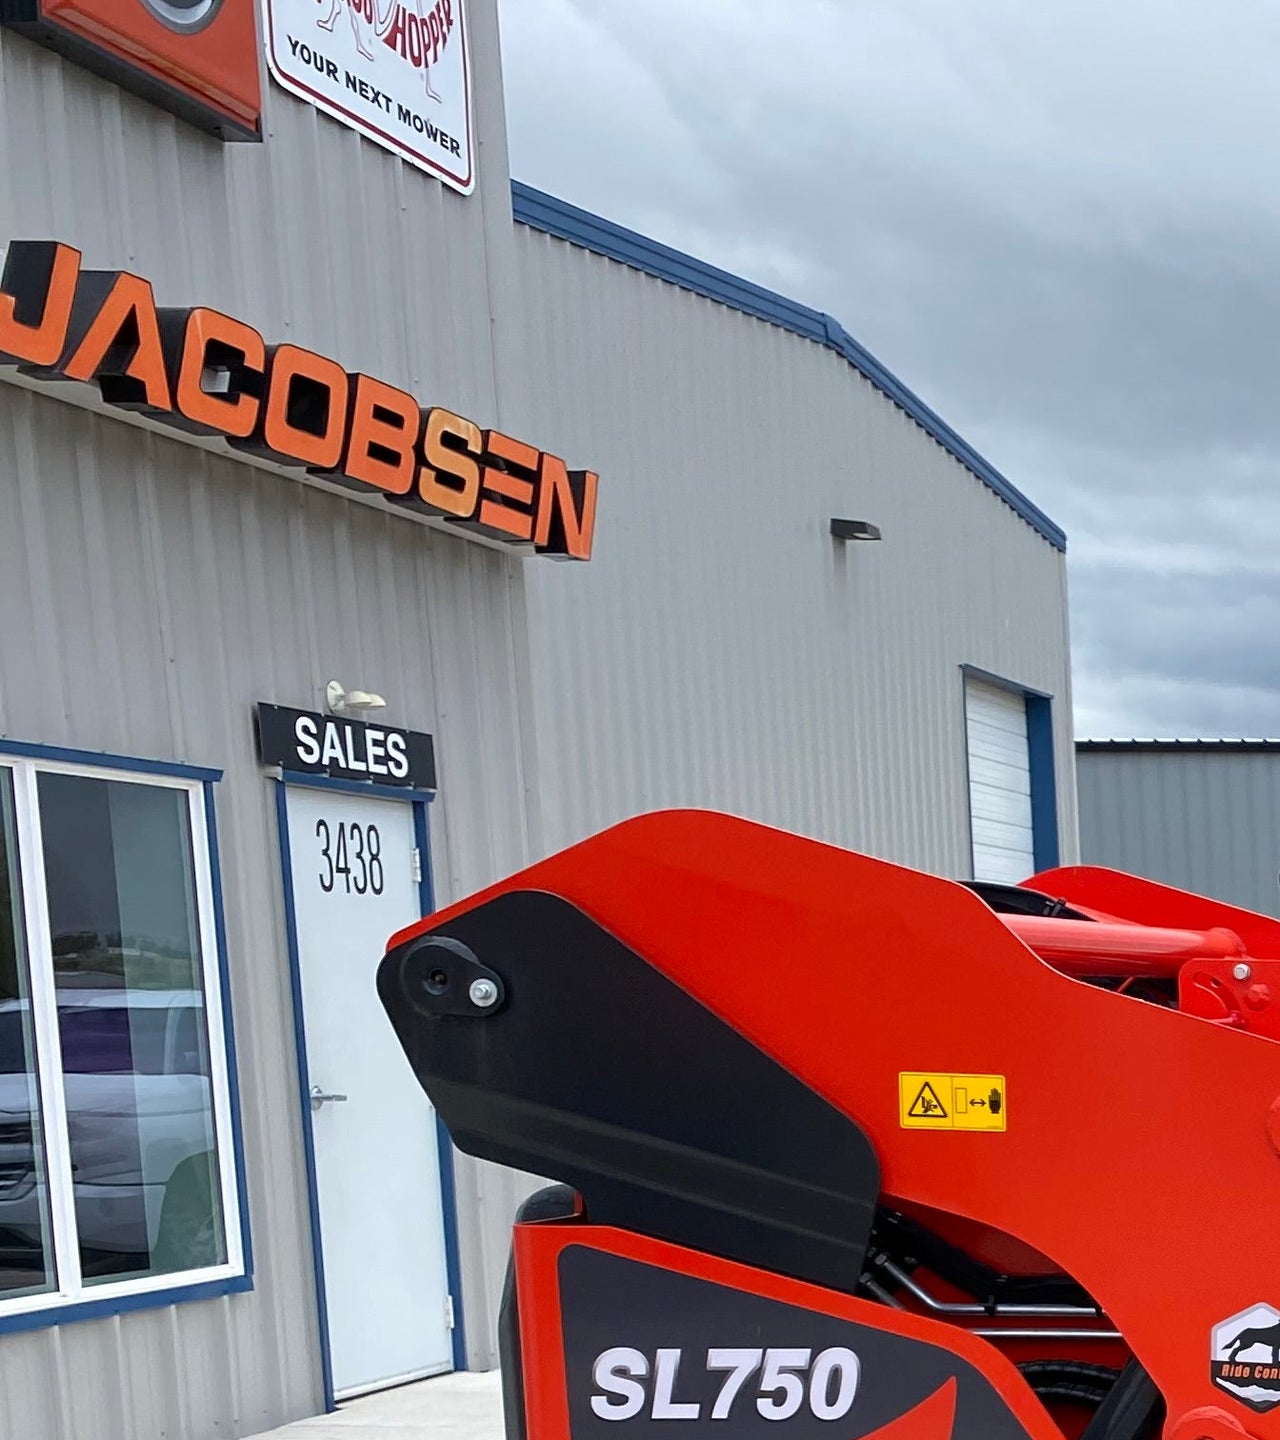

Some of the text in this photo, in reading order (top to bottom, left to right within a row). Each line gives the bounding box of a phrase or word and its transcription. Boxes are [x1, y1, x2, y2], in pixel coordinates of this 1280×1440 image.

[286, 33, 461, 158] YOUR NEXT MOWER
[0, 240, 598, 562] JACOBSEN
[295, 716, 409, 778] SALES
[315, 818, 384, 896] 3438
[590, 1346, 862, 1421] SL750
[1221, 1364, 1250, 1378] Ride
